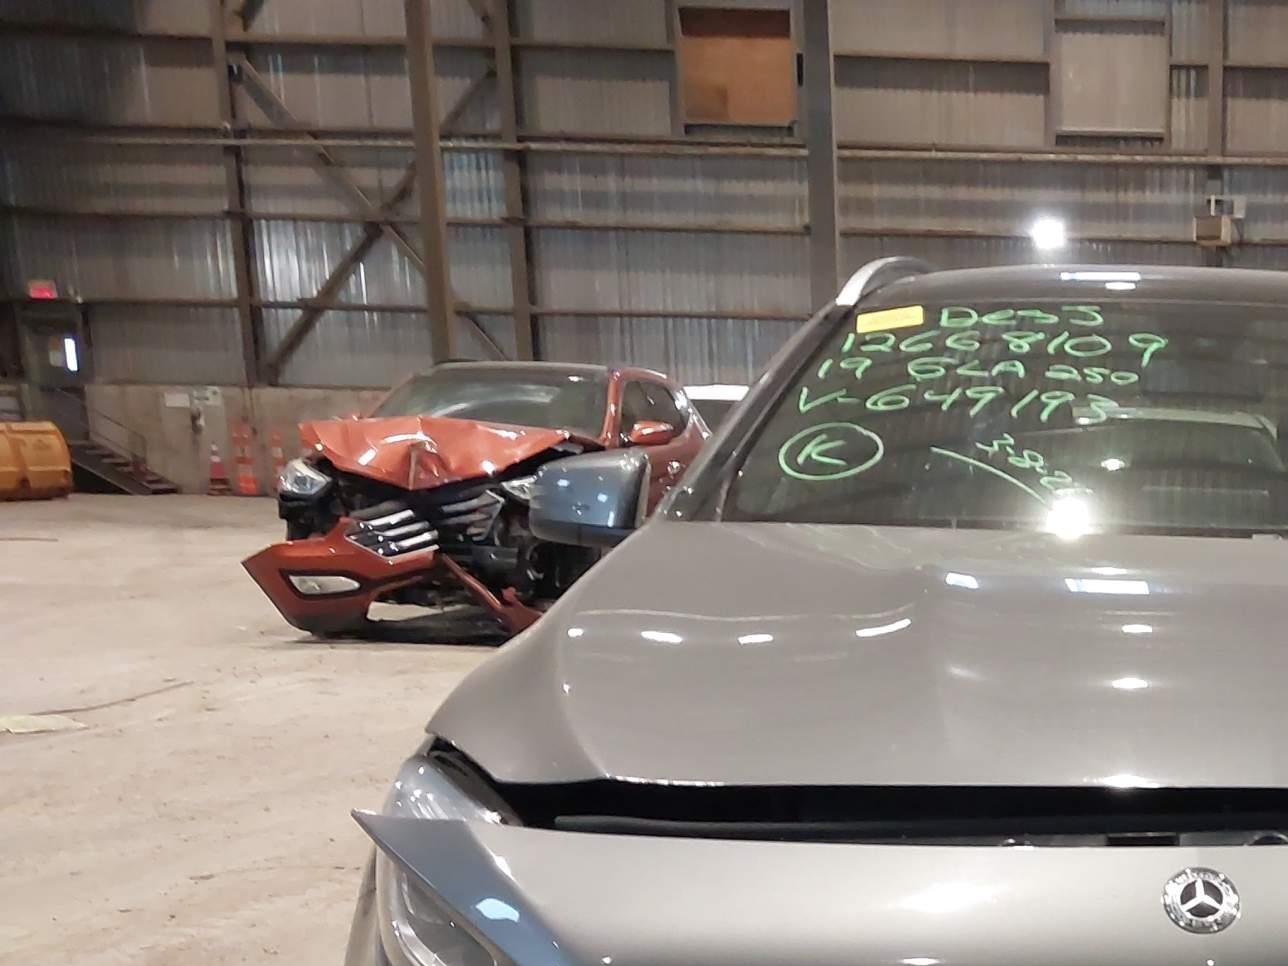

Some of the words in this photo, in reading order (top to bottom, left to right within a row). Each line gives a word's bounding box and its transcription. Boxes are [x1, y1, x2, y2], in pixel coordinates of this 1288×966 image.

[841, 330, 1169, 368] 12668109
[817, 356, 873, 380] 19
[907, 356, 1026, 381] GLA
[1045, 364, 1139, 385] 250
[799, 383, 1120, 424] V-649193
[797, 433, 847, 466] K
